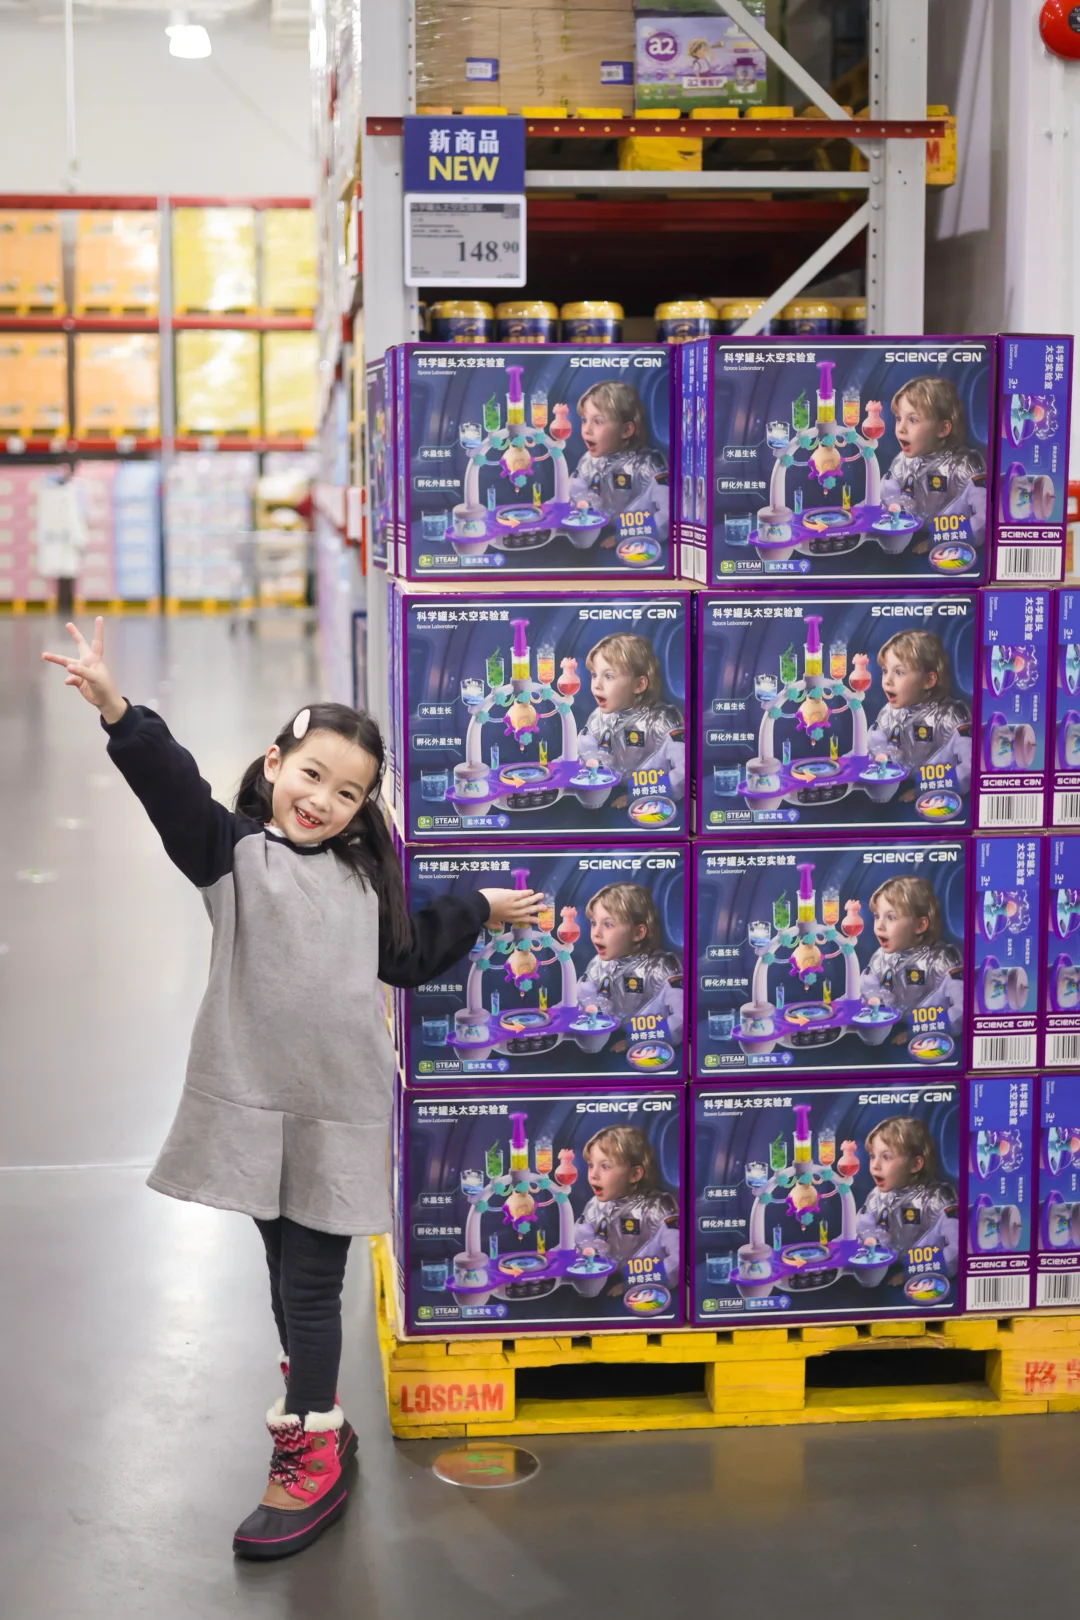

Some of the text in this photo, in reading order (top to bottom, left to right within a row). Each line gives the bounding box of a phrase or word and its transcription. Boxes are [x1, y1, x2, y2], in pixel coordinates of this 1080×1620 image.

[648, 37, 675, 55] a2
[429, 128, 499, 154] 新商品
[429, 156, 499, 181] NEW
[418, 357, 505, 368] 科学罐头太空实验室
[724, 352, 816, 363] 科学罐头太空实验室
[727, 450, 757, 458] 水晶生长
[619, 510, 650, 527] 100+
[933, 513, 966, 532] 100+
[620, 526, 652, 537] 神奇实验
[933, 531, 967, 542] 神奇实验
[724, 561, 733, 569] 3+
[417, 610, 509, 622] 科学罐头太空实验室
[713, 607, 803, 618] 科学罐头太空实验室
[422, 707, 452, 715] 水晶生长
[716, 702, 745, 710] 水晶生长
[632, 768, 665, 786] 100+
[920, 763, 952, 780] 100+
[920, 779, 953, 790] 神奇实验
[632, 785, 666, 796] 神奇实验
[421, 817, 430, 825] 3+
[418, 861, 510, 872] 科学罐头太空实验室
[706, 855, 796, 867] 科学罐头太空实验室
[710, 948, 739, 957] 水晶生长
[912, 1006, 944, 1023] 100+
[630, 1014, 663, 1031] 100+
[912, 1022, 945, 1033] 神奇实验
[631, 1030, 664, 1041] 神奇实验
[704, 1097, 792, 1109] 科学罐头太空实验室
[418, 1105, 508, 1116] 科学罐头太空实验室
[708, 1189, 736, 1197] 水晶生长
[423, 1196, 452, 1204] 水晶生长
[908, 1246, 939, 1263] 100+
[627, 1256, 659, 1274] 100+
[908, 1262, 941, 1274] 神奇实验
[628, 1273, 661, 1284] 神奇实验
[706, 1300, 715, 1308] 3+
[401, 1383, 504, 1413] LOSCAM
